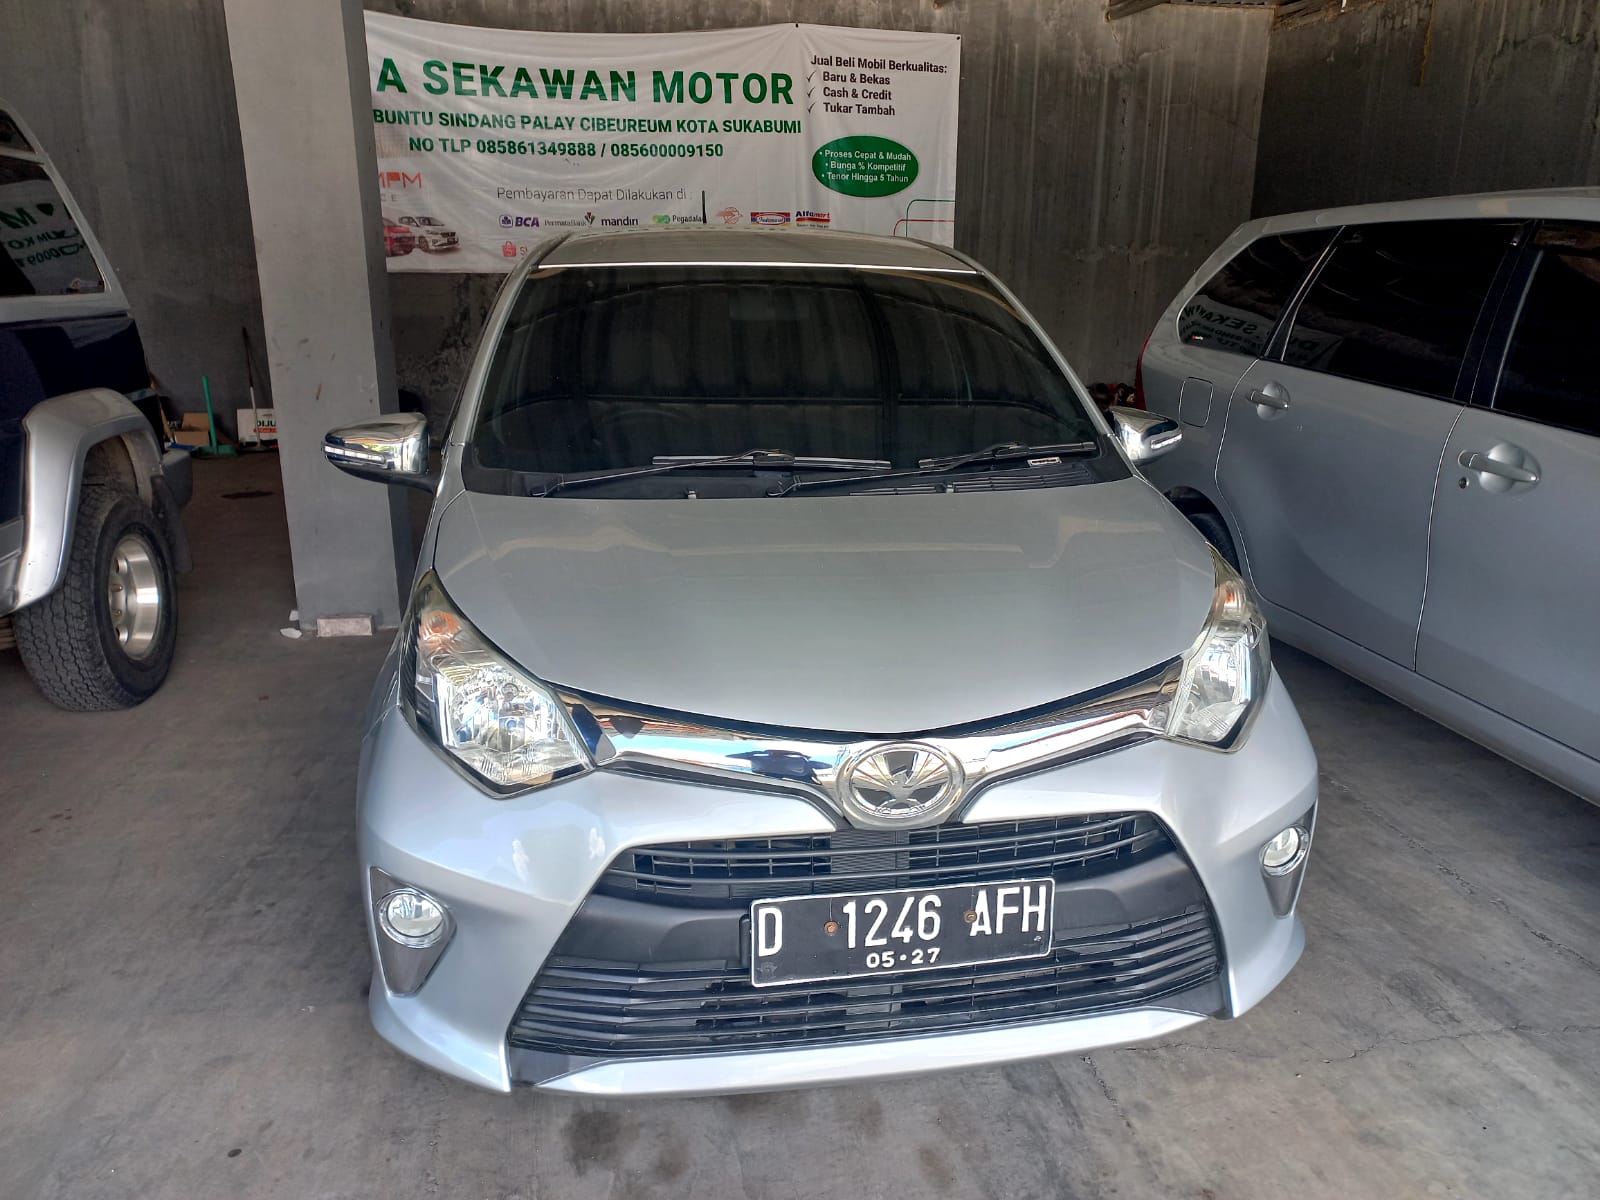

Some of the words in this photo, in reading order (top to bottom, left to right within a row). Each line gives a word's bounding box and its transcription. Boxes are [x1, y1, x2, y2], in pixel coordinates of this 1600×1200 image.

[811, 55, 832, 66] Jual
[836, 57, 855, 68] Beli
[858, 58, 886, 70] Mobil
[889, 60, 947, 74] Berkualitas:
[422, 59, 636, 102] SEKAWAN
[652, 71, 794, 105] MOTOR
[823, 71, 847, 82] Baru
[849, 73, 857, 83] &
[860, 74, 890, 85] Bekas
[823, 87, 848, 98] Cash
[851, 88, 858, 99] &
[861, 89, 892, 100] Credit
[823, 102, 853, 114] Tukar
[855, 103, 895, 116] Tambah
[373, 109, 433, 126] BUNTU
[439, 112, 516, 129] SINDANG
[521, 115, 575, 131] PALAY
[580, 117, 672, 132] CIBEUREUM
[677, 120, 719, 133] KOTA
[723, 120, 801, 134] SUKABUMI
[409, 137, 434, 152] NO
[439, 138, 471, 153] TLP
[476, 140, 596, 157] 085861349888
[600, 143, 606, 158] /
[610, 143, 723, 158] 085600009150
[824, 149, 852, 159] Proses
[854, 150, 876, 160] Cepat
[879, 151, 884, 160] &
[886, 152, 911, 161] Mudah
[830, 161, 856, 171] Bunga
[858, 162, 865, 170] %
[867, 162, 906, 172] Kompetitif
[827, 172, 849, 180] Tenor
[851, 173, 877, 183] Hingga
[887, 174, 909, 183] Tahun
[497, 187, 574, 202] Pembayaran
[578, 188, 612, 203] Dapat
[616, 188, 673, 200] Dilakukan
[515, 216, 540, 227] BCA
[758, 907, 783, 957] D
[842, 895, 941, 949] 1246
[970, 885, 1047, 937] AFH
